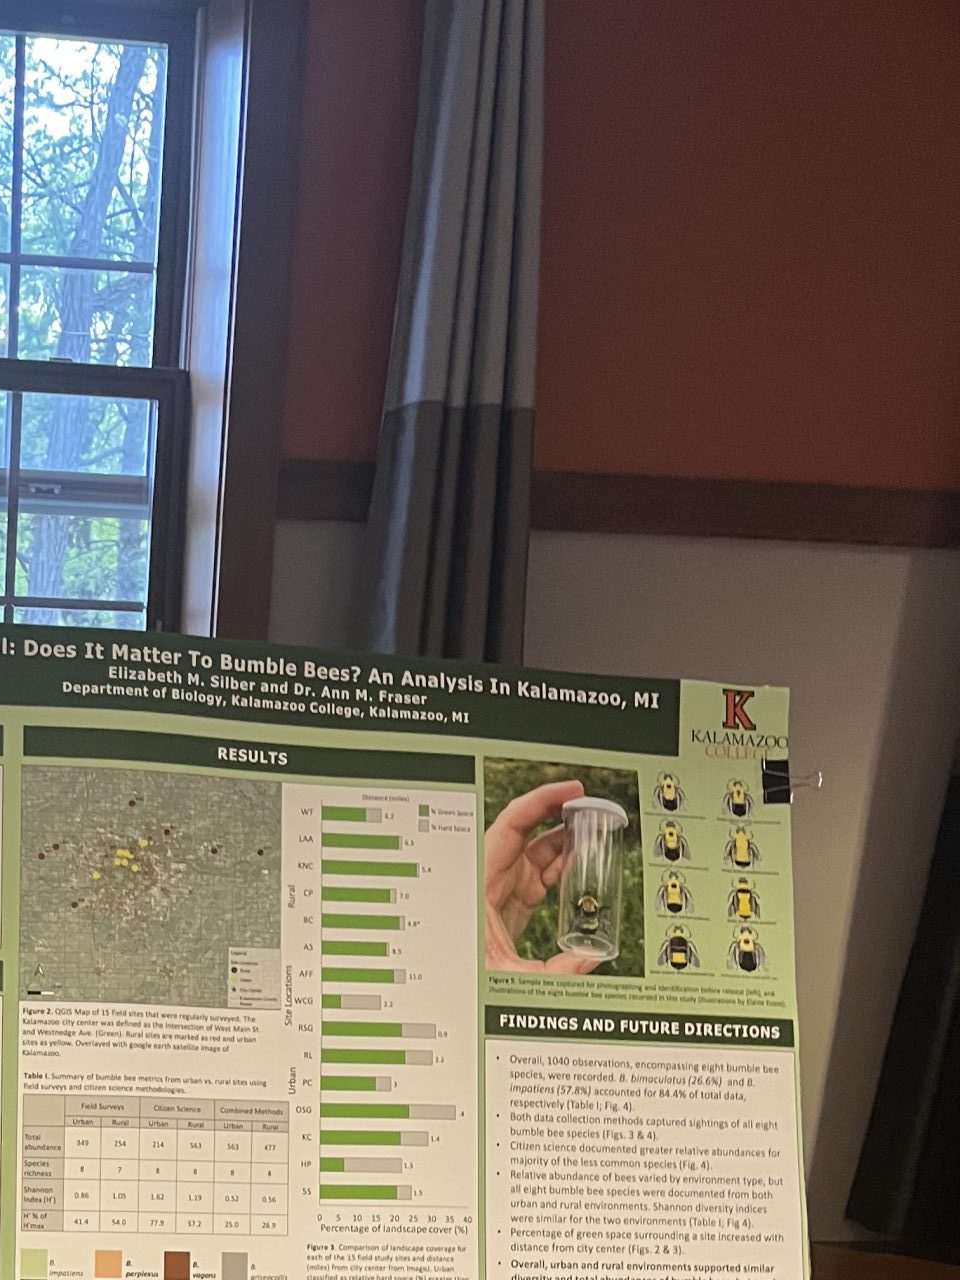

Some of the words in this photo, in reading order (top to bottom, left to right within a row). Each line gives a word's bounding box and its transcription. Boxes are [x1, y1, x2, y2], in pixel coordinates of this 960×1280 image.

[24, 639, 76, 658] Does
[84, 642, 104, 659] It
[112, 643, 182, 665] Matter
[187, 649, 212, 668] To
[220, 653, 296, 676] Bumble
[303, 660, 361, 682] Bees?
[368, 667, 393, 685] An
[401, 670, 483, 693] Analysis
[489, 677, 510, 695] In
[517, 680, 626, 710] Kalamazoo,
[634, 691, 659, 709] MI
[108, 665, 182, 684] Elizabeth
[187, 672, 204, 686] M.
[210, 674, 255, 691] Silber
[260, 680, 288, 694] and
[294, 682, 315, 697] Dr.
[320, 685, 349, 700] Ann
[355, 688, 372, 702] M.
[378, 689, 427, 705] Fraser
[62, 681, 149, 697] Department
[152, 686, 167, 698] of
[171, 687, 226, 707] Biology,
[231, 694, 305, 712] Kalamazoo
[309, 701, 364, 718] College,
[369, 705, 447, 723] Kalamazoo,
[451, 711, 469, 723] MI
[722, 688, 756, 731] K
[691, 729, 789, 749] KALAMAZOO
[217, 746, 287, 765] RESULTS
[300, 807, 313, 815] WT
[298, 834, 313, 843] LAA
[297, 861, 313, 870] KNC
[288, 885, 296, 908] Rural
[303, 888, 313, 896] CP
[303, 915, 313, 924] BC
[303, 943, 313, 951] AS
[299, 969, 313, 977] AFF
[284, 965, 293, 1006] Locations
[294, 996, 313, 1005] WCG
[284, 1008, 293, 1026] Site
[298, 1023, 313, 1032] RSG
[499, 1013, 578, 1030] FINDINGS
[582, 1017, 615, 1032] AND
[620, 1019, 679, 1035] FUTURE
[684, 1022, 780, 1039] DIRECTIONS
[509, 1054, 544, 1066] Overall,
[547, 1055, 570, 1066] 1040
[572, 1056, 632, 1070] observations,
[634, 1061, 699, 1073] encompassing
[701, 1062, 724, 1073] eight
[726, 1062, 760, 1073] bumble
[762, 1064, 779, 1074] bee
[288, 1067, 296, 1094] Urban
[302, 1078, 312, 1086] PC
[295, 1105, 312, 1113] OSG
[510, 1111, 531, 1122] Both
[533, 1112, 554, 1123] data
[556, 1113, 600, 1124] collection
[603, 1115, 643, 1126] methods
[645, 1117, 686, 1128] captured
[689, 1117, 728, 1130] sightings
[730, 1118, 740, 1128] of
[742, 1119, 753, 1129] all
[755, 1119, 777, 1131] eight
[301, 1133, 312, 1141] KC
[316, 1213, 322, 1221] 0
[335, 1213, 341, 1222] 5
[353, 1213, 362, 1222] 10
[371, 1213, 380, 1222] 15
[390, 1214, 400, 1222] 20
[408, 1214, 418, 1223] 25
[427, 1214, 436, 1223] 30
[445, 1215, 454, 1223] 35
[463, 1215, 472, 1224] 40
[320, 1223, 369, 1234] Percentage
[371, 1223, 381, 1232] of
[382, 1224, 427, 1235] landscape
[428, 1226, 452, 1234] cover
[454, 1225, 468, 1236] (%)
